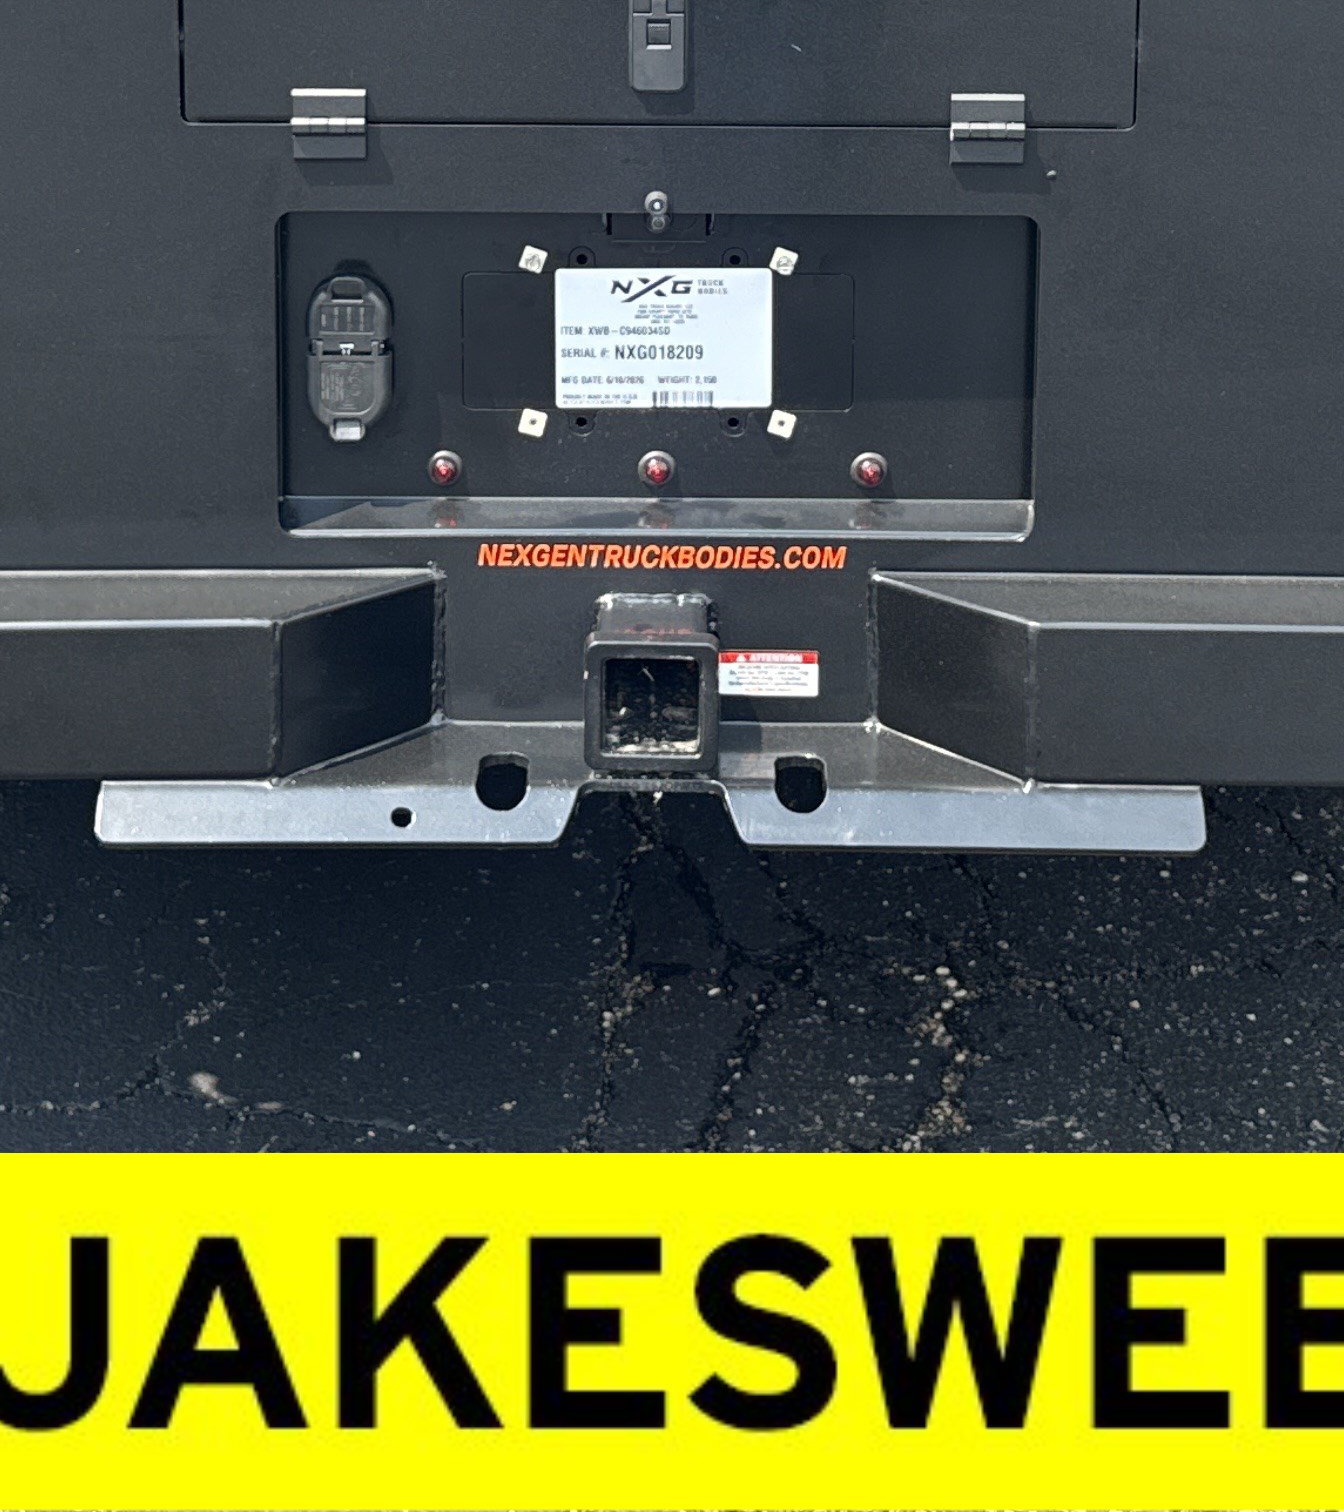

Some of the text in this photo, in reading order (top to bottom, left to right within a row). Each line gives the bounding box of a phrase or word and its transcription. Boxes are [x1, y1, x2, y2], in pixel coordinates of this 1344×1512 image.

[611, 275, 693, 303] NXG
[561, 348, 597, 358] SERIAL
[615, 344, 704, 360] NXG018209
[476, 544, 847, 571] NEXGENTRUCKBODIES.COM
